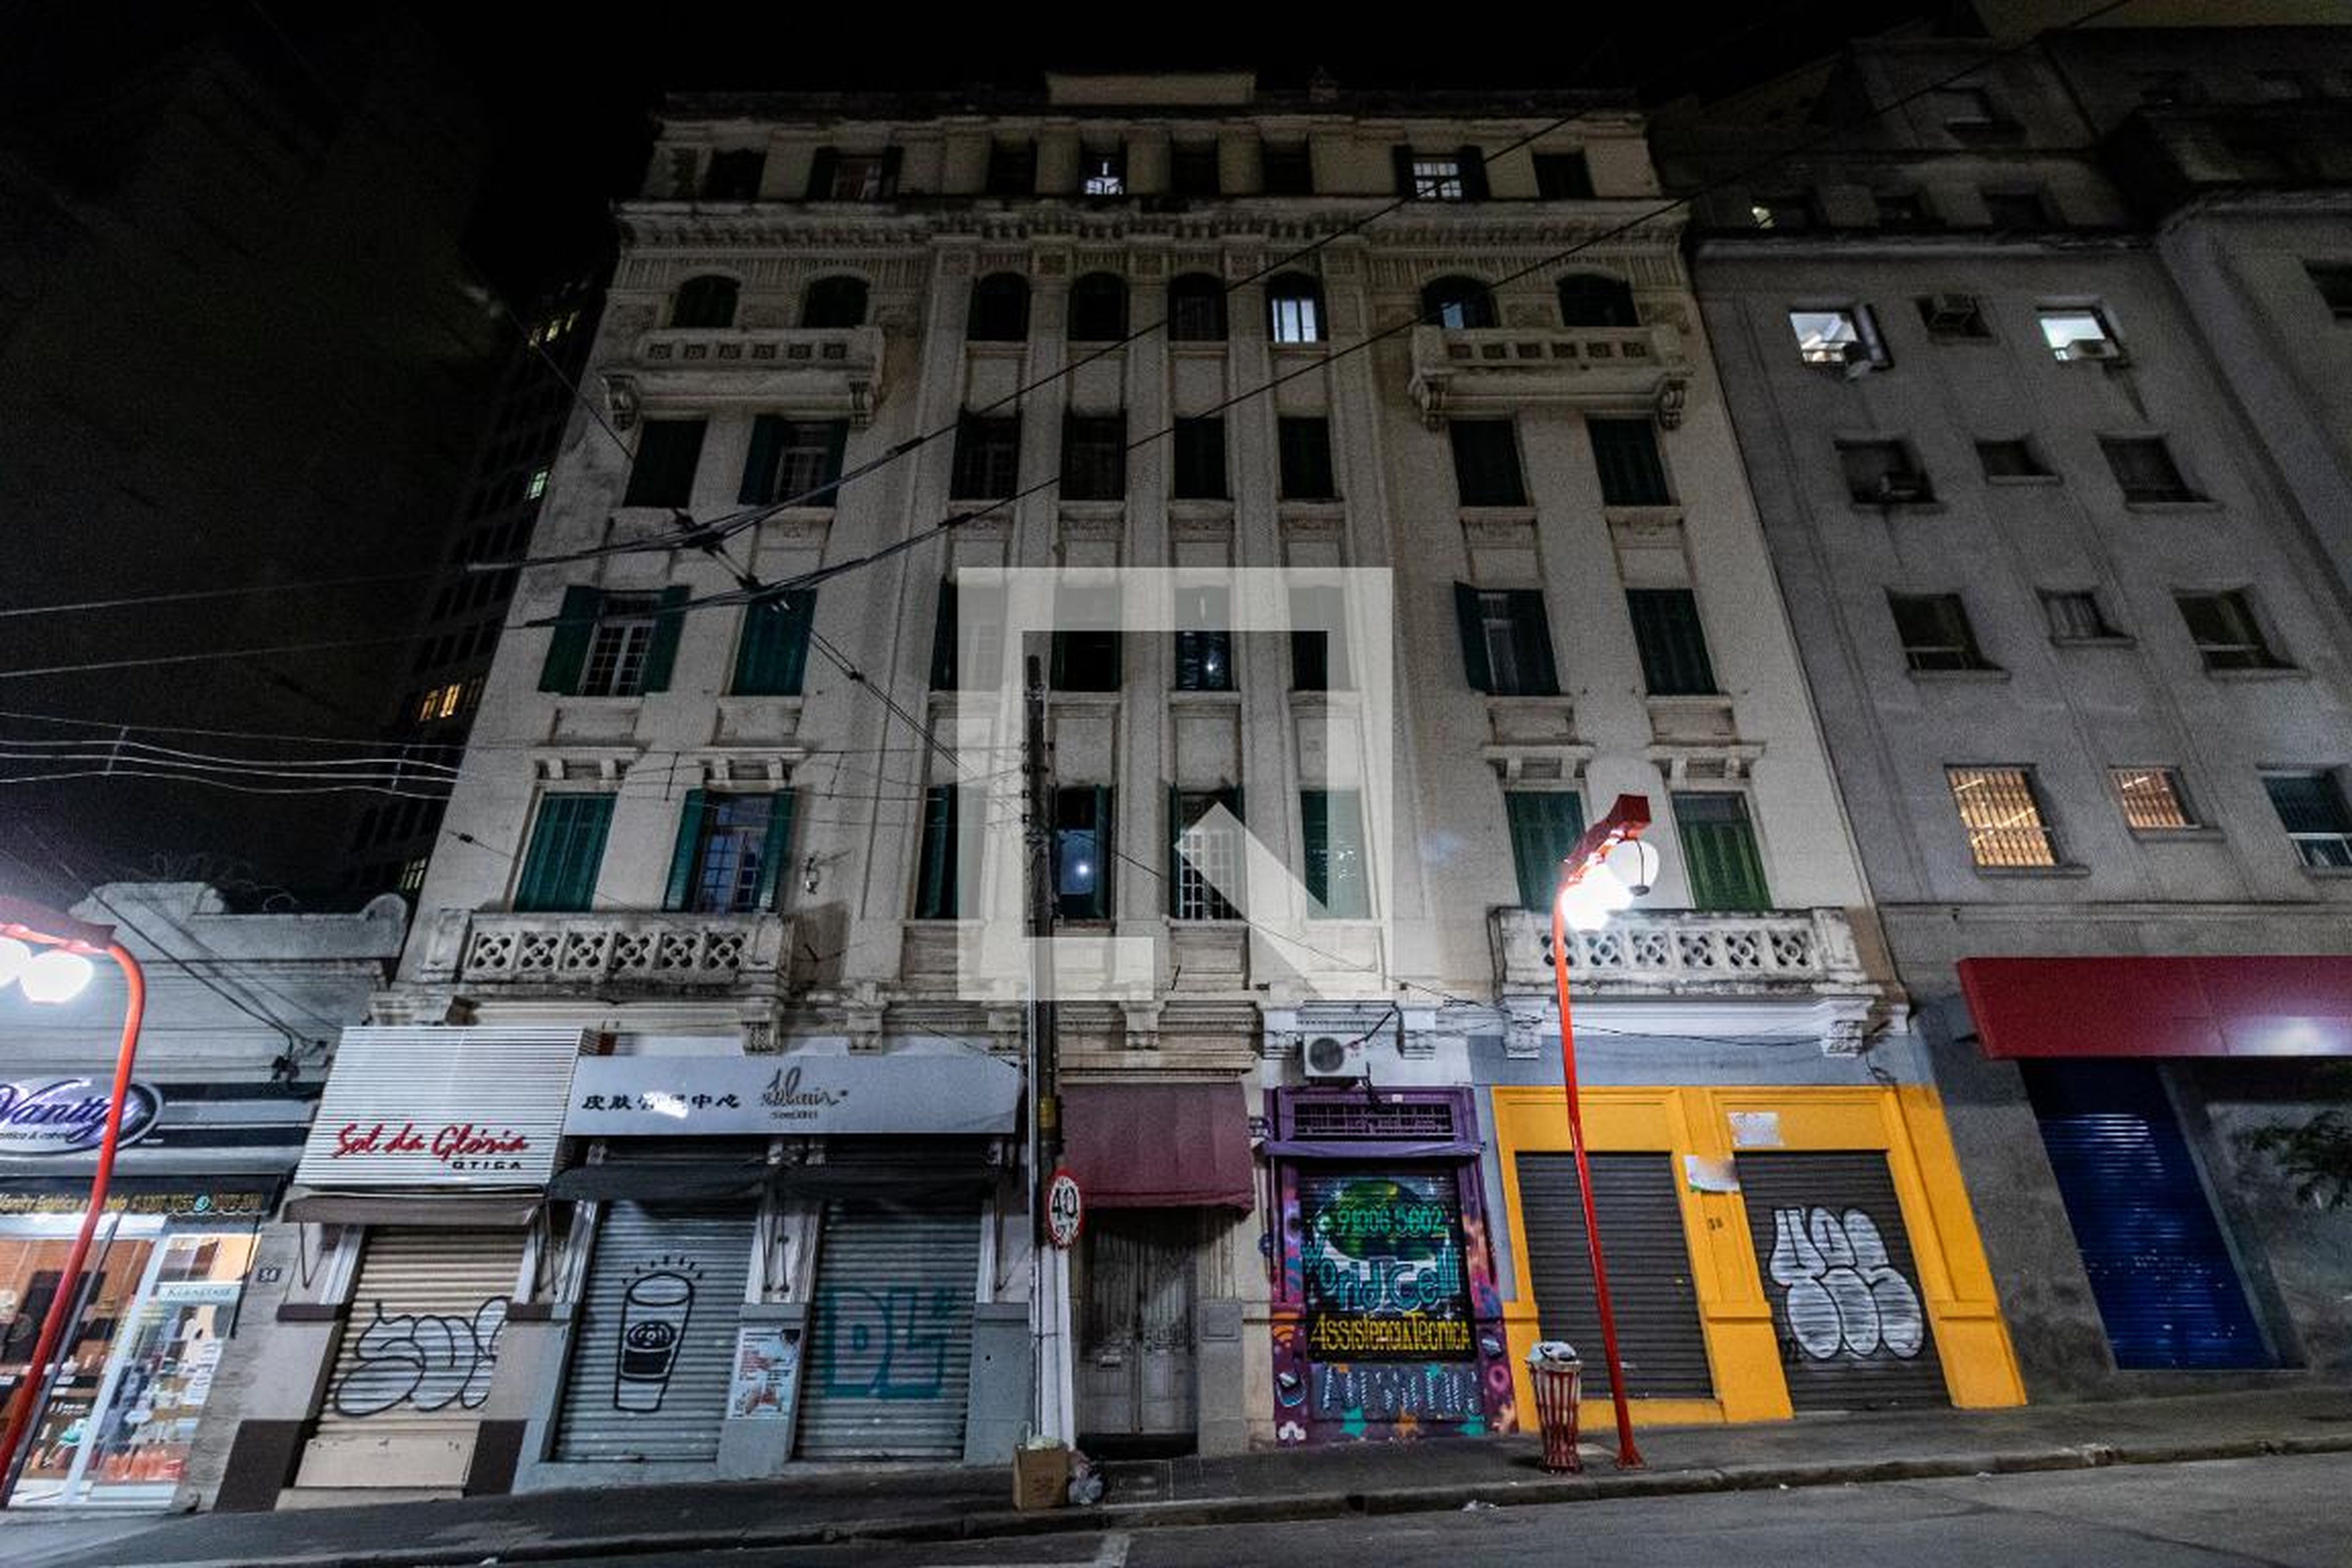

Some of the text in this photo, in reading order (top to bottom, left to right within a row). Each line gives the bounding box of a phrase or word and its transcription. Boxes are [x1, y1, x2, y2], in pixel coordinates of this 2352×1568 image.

[581, 1093, 741, 1111] 皮肤中心
[333, 1123, 382, 1158] Sol
[384, 1123, 424, 1153] da
[1052, 1186, 1077, 1220] 40
